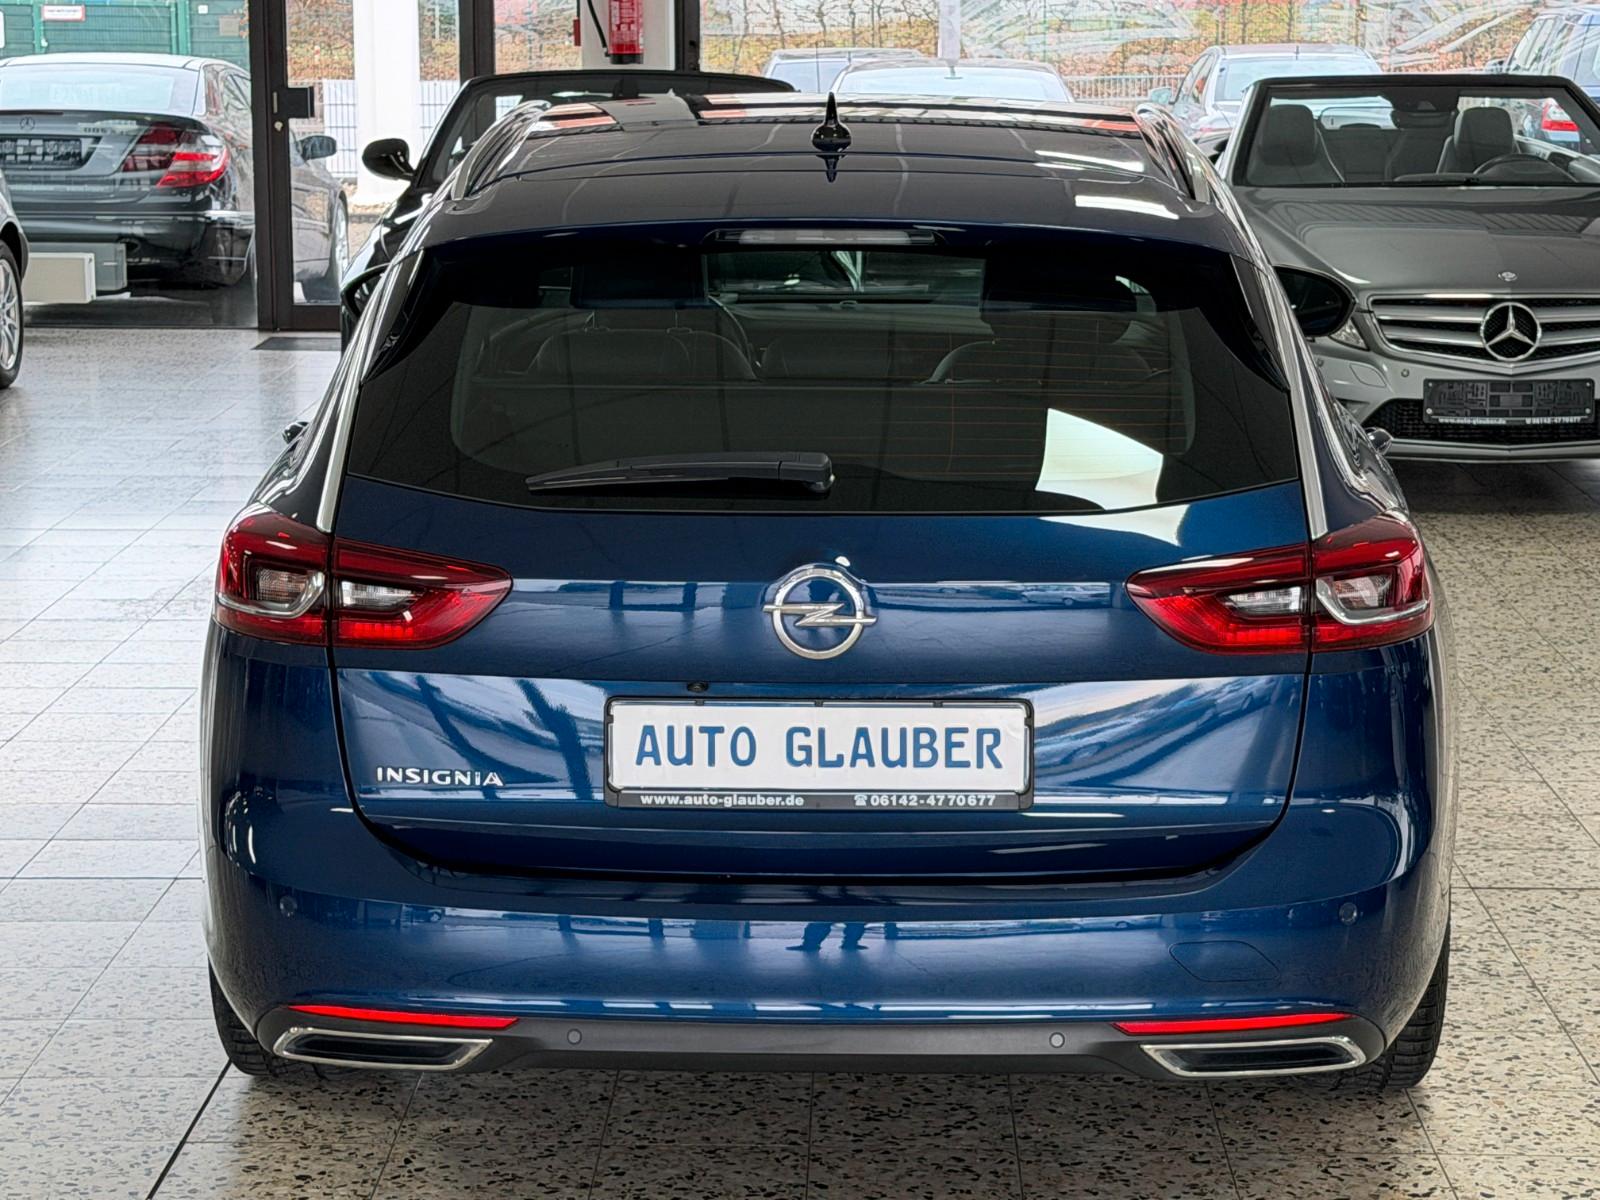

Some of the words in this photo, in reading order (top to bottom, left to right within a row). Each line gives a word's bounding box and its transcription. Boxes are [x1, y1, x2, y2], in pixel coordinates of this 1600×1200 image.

[635, 724, 757, 767] AUTO
[785, 726, 1004, 770] GLAUBER
[376, 766, 504, 787] INSIGNIA
[640, 793, 804, 808] www.auto-glauber.de
[870, 794, 996, 807] 06142-4770677
